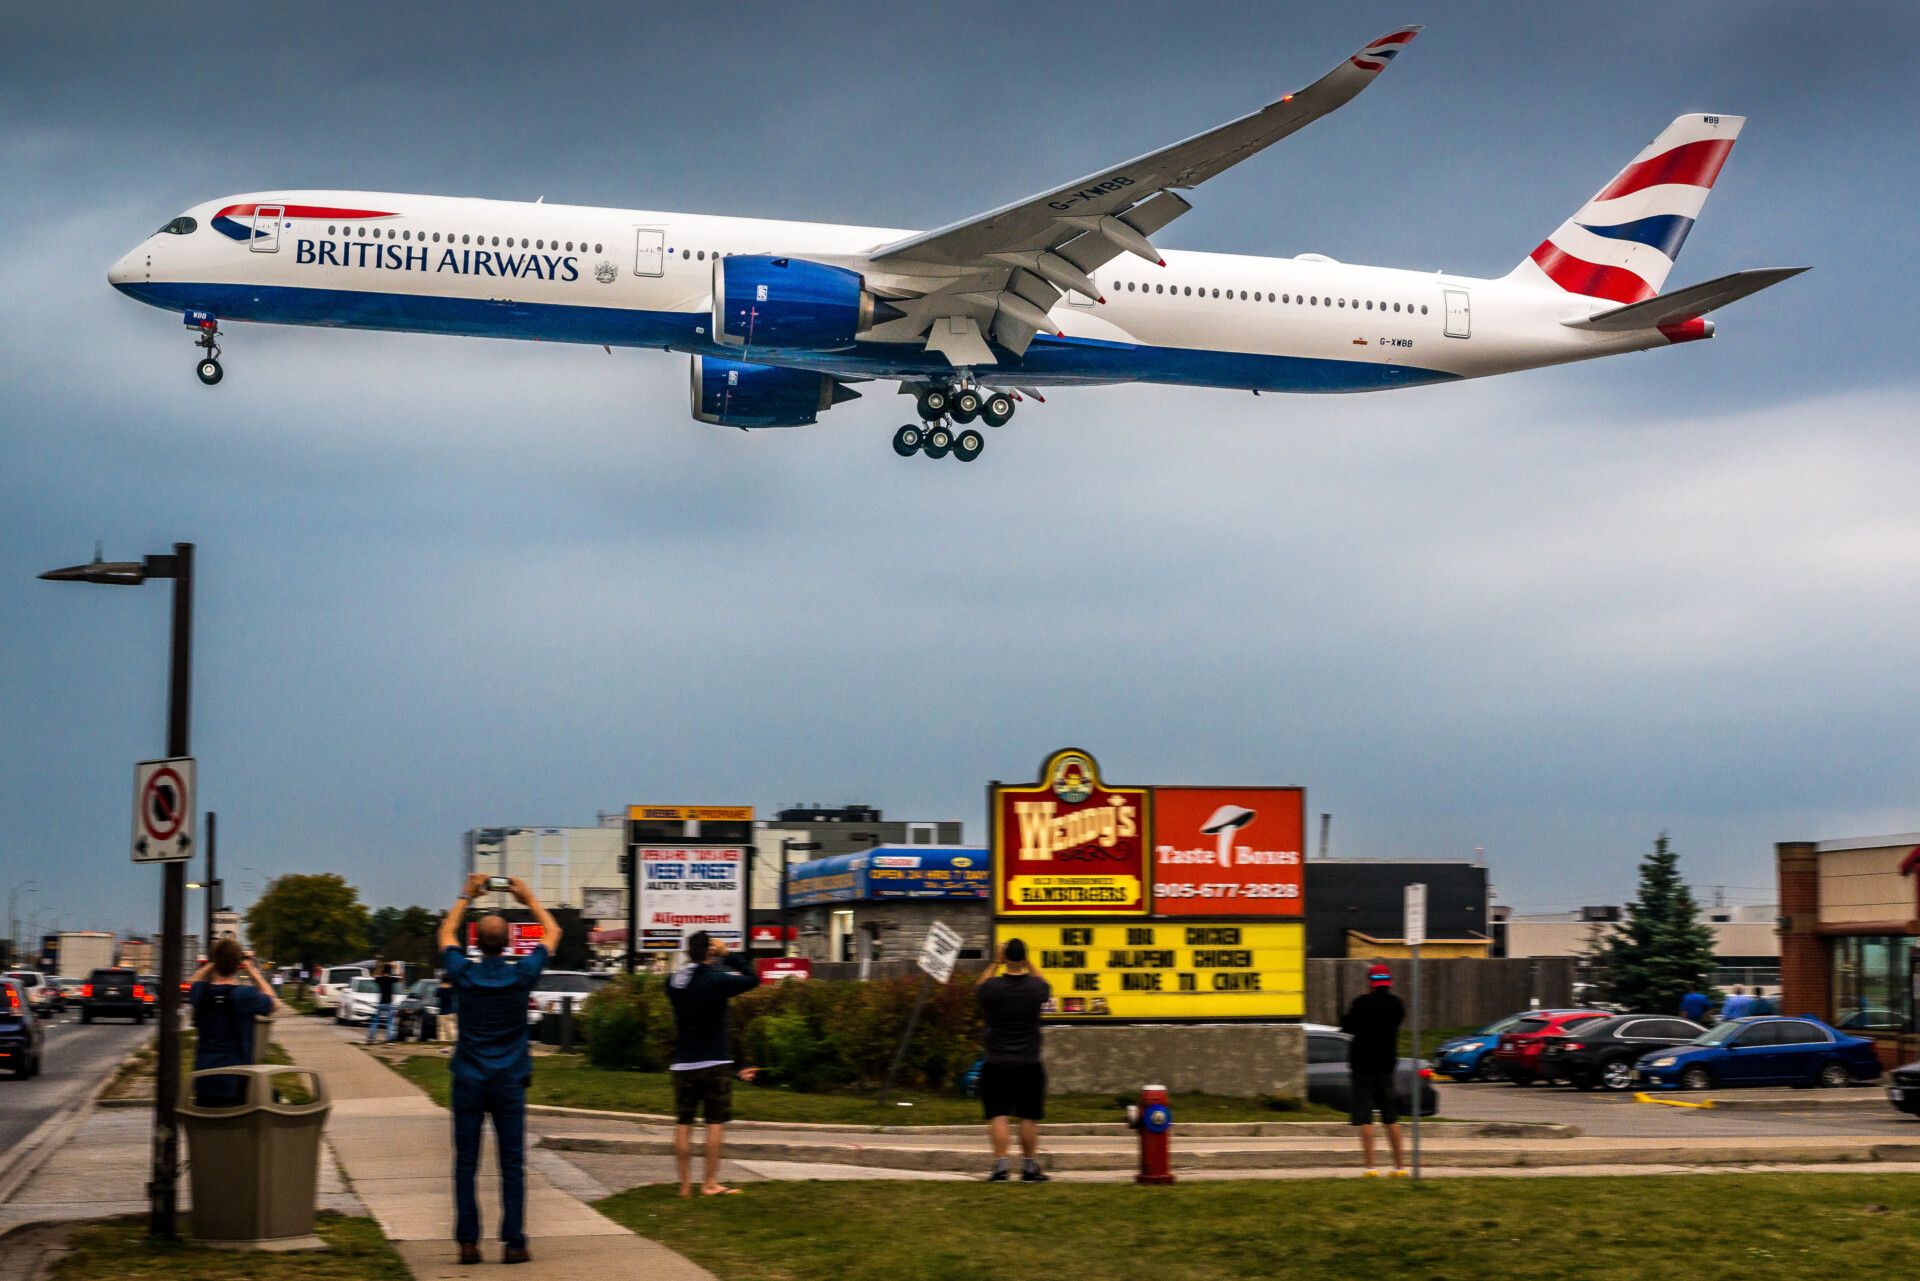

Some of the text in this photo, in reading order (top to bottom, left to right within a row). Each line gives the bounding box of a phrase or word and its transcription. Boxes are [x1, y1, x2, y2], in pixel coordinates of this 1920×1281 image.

[1704, 115, 1719, 124] WBB
[1047, 176, 1136, 210] G-XWBB
[296, 239, 579, 281] BRITISH AIRWAYS
[1380, 337, 1413, 347] G-XWBB
[1156, 845, 1300, 865] Taste Boxes
[646, 881, 738, 890] AUTO REPAIRS
[1153, 883, 1300, 898] 905-677-2828
[653, 912, 732, 926] Alignment
[1061, 928, 1094, 945] NEW
[1185, 928, 1242, 945] CHICKEN
[1192, 950, 1253, 968] CHICKEN
[1073, 973, 1262, 991] ARE MADE TO CRAVE
